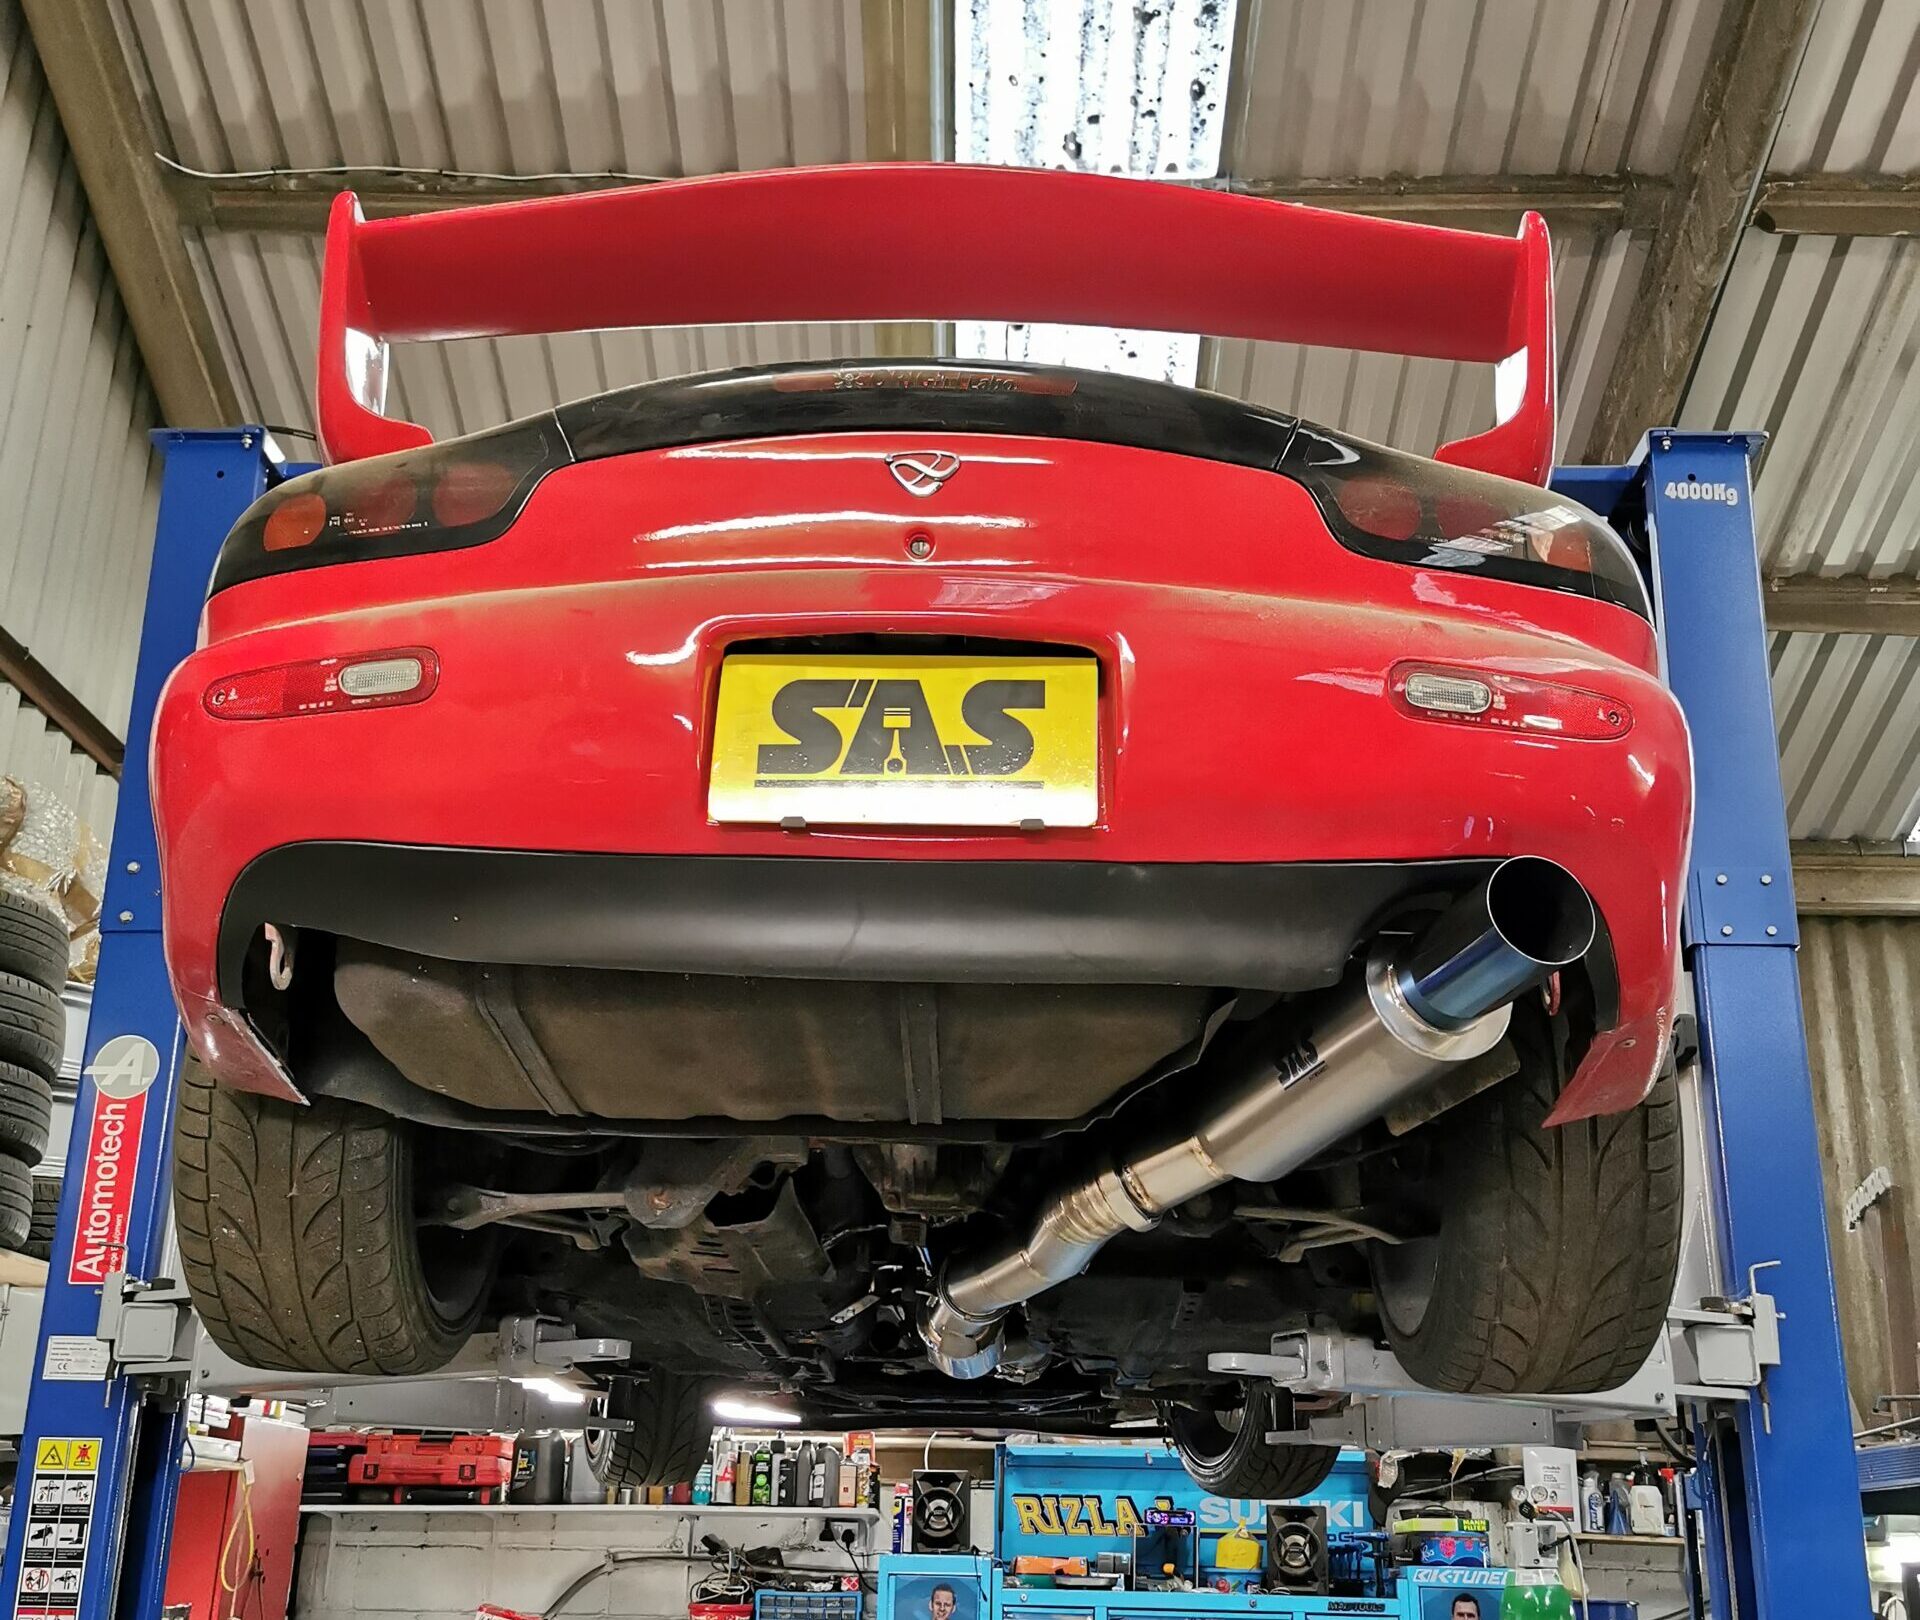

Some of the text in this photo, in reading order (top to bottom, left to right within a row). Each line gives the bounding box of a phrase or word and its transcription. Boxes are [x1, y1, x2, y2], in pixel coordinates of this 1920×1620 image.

[1664, 482, 1738, 506] 4000Kg
[757, 679, 1046, 775] SAS
[76, 1103, 127, 1278] Automotech
[1012, 1494, 1148, 1537] RIZLA
[1200, 1496, 1364, 1527] SUKI
